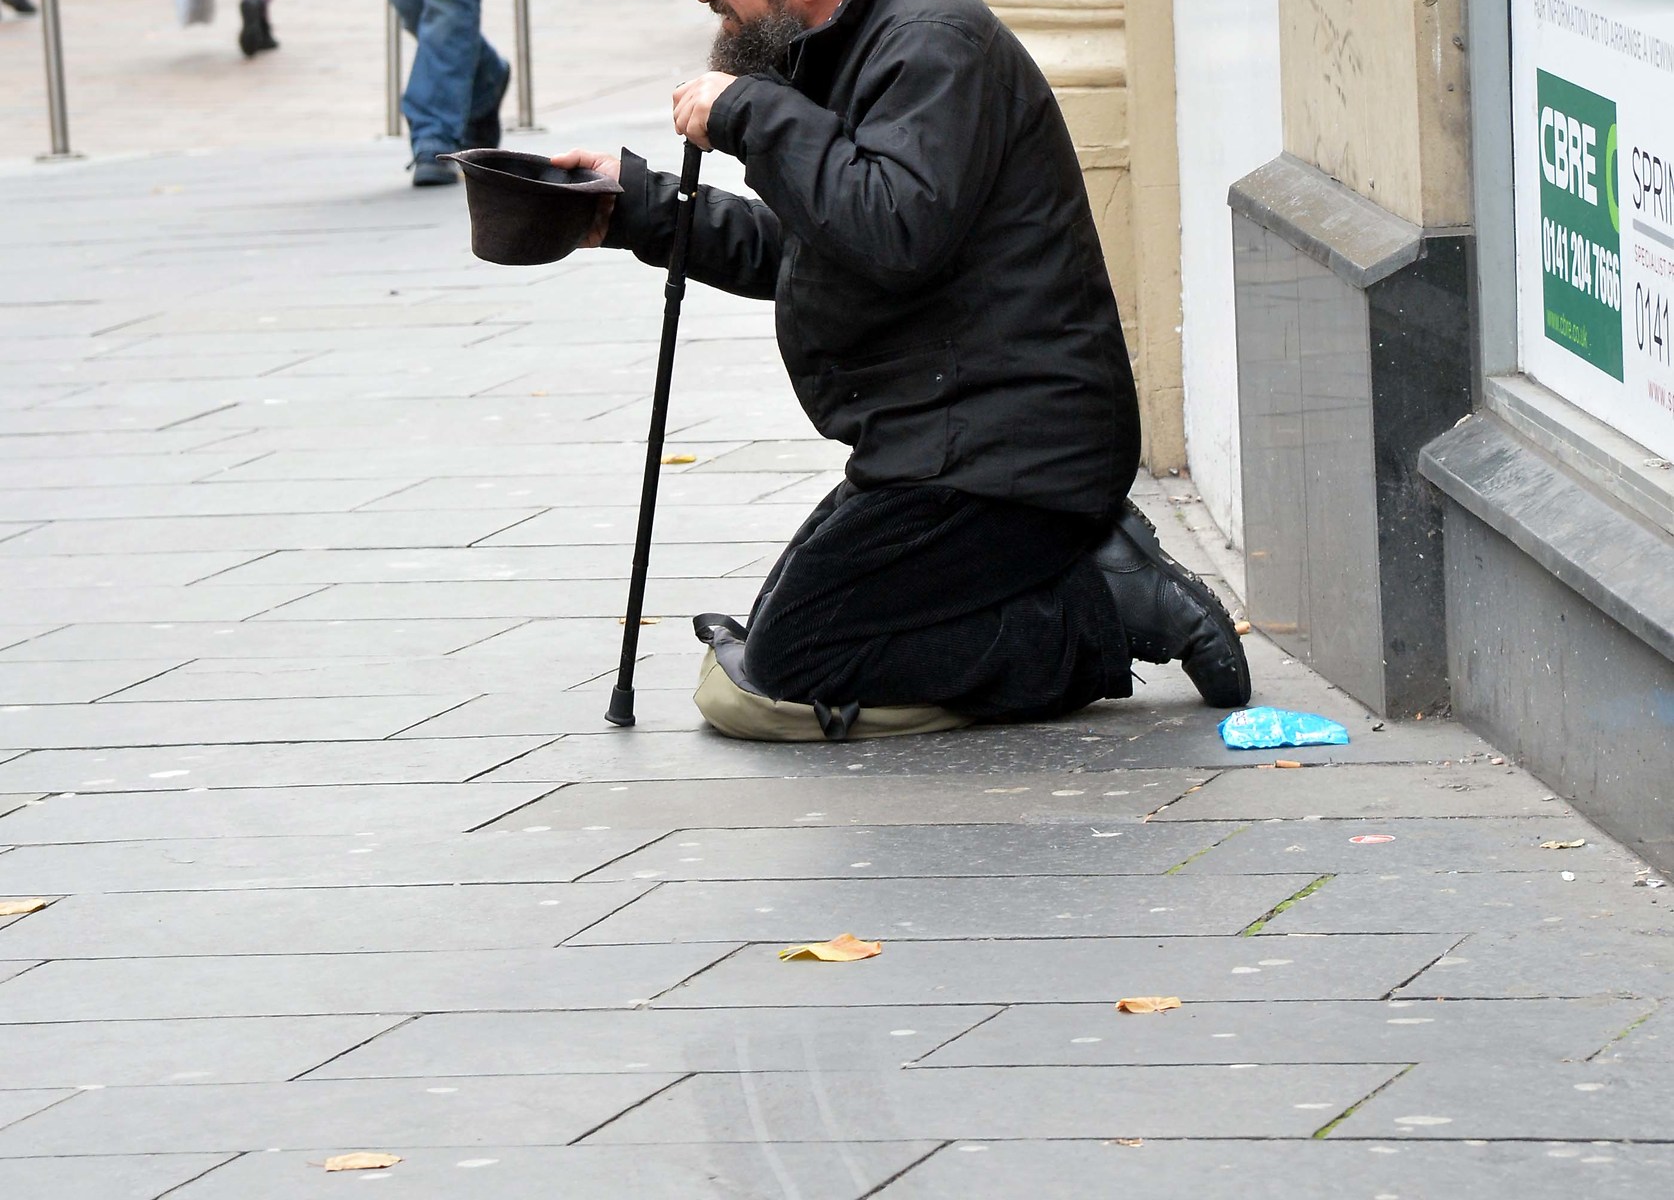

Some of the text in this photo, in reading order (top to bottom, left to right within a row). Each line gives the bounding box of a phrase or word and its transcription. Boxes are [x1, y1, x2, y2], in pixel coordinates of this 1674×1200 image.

[1540, 106, 1598, 207] CBRE
[1543, 216, 1621, 312] 0141 204 7666
[1634, 281, 1670, 367] 0141
